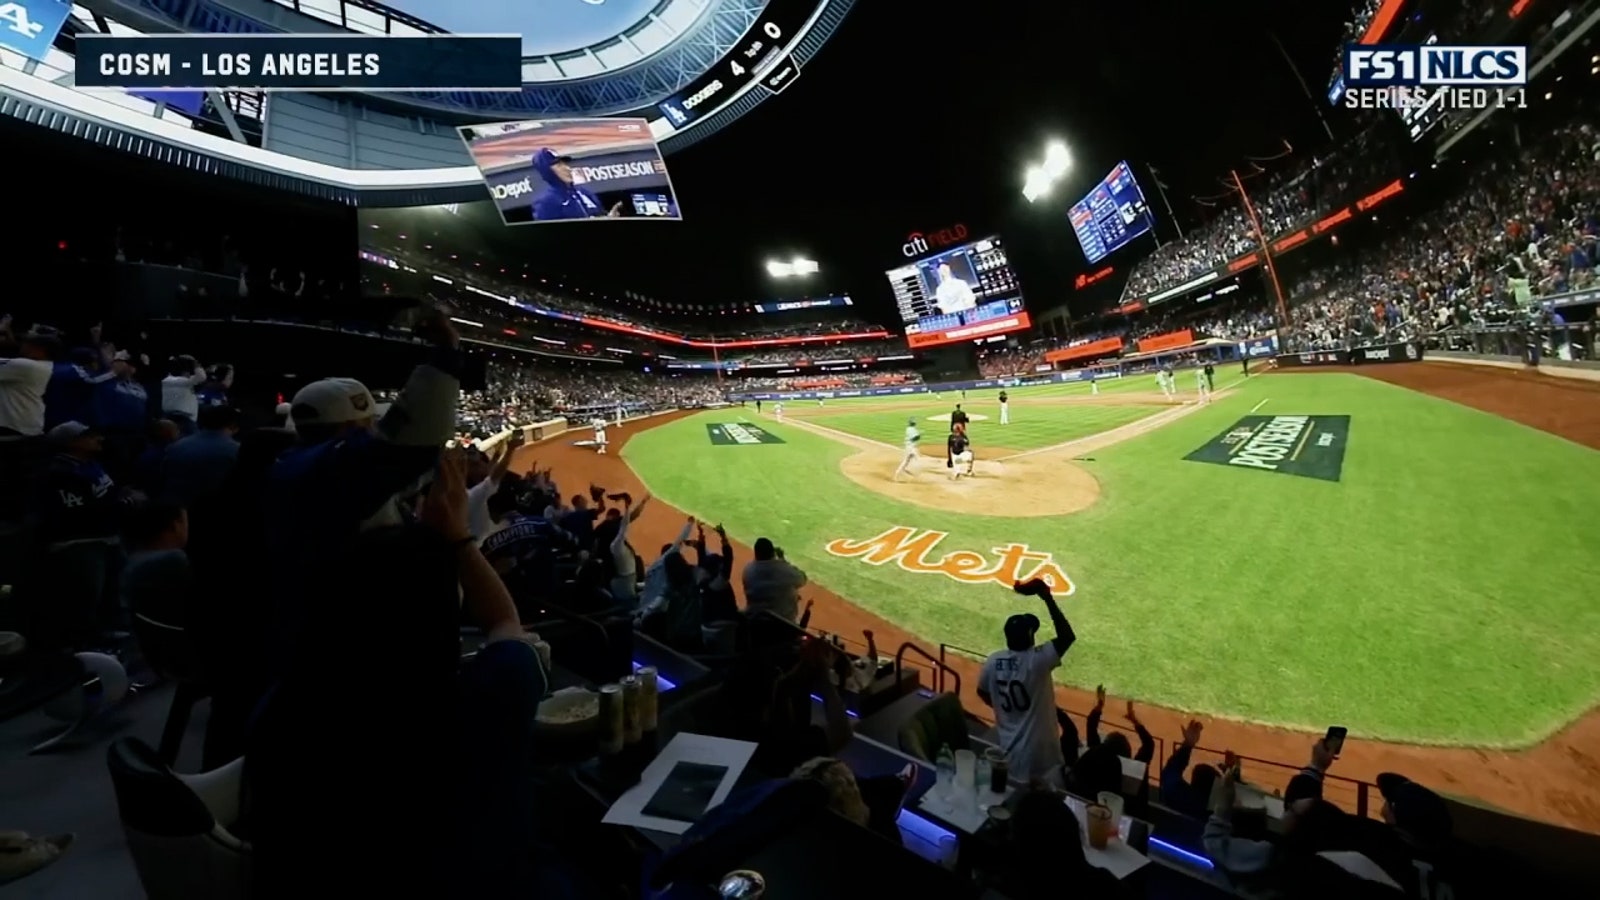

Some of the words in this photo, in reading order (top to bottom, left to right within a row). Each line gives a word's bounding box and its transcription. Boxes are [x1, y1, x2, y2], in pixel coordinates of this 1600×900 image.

[682, 79, 723, 109] DODGERS
[730, 60, 745, 76] 4
[764, 22, 782, 39] 0
[584, 161, 654, 183] POSTSEASON
[56, 488, 86, 509] LA
[826, 526, 1076, 596] Mets
[995, 680, 1031, 713] 50
